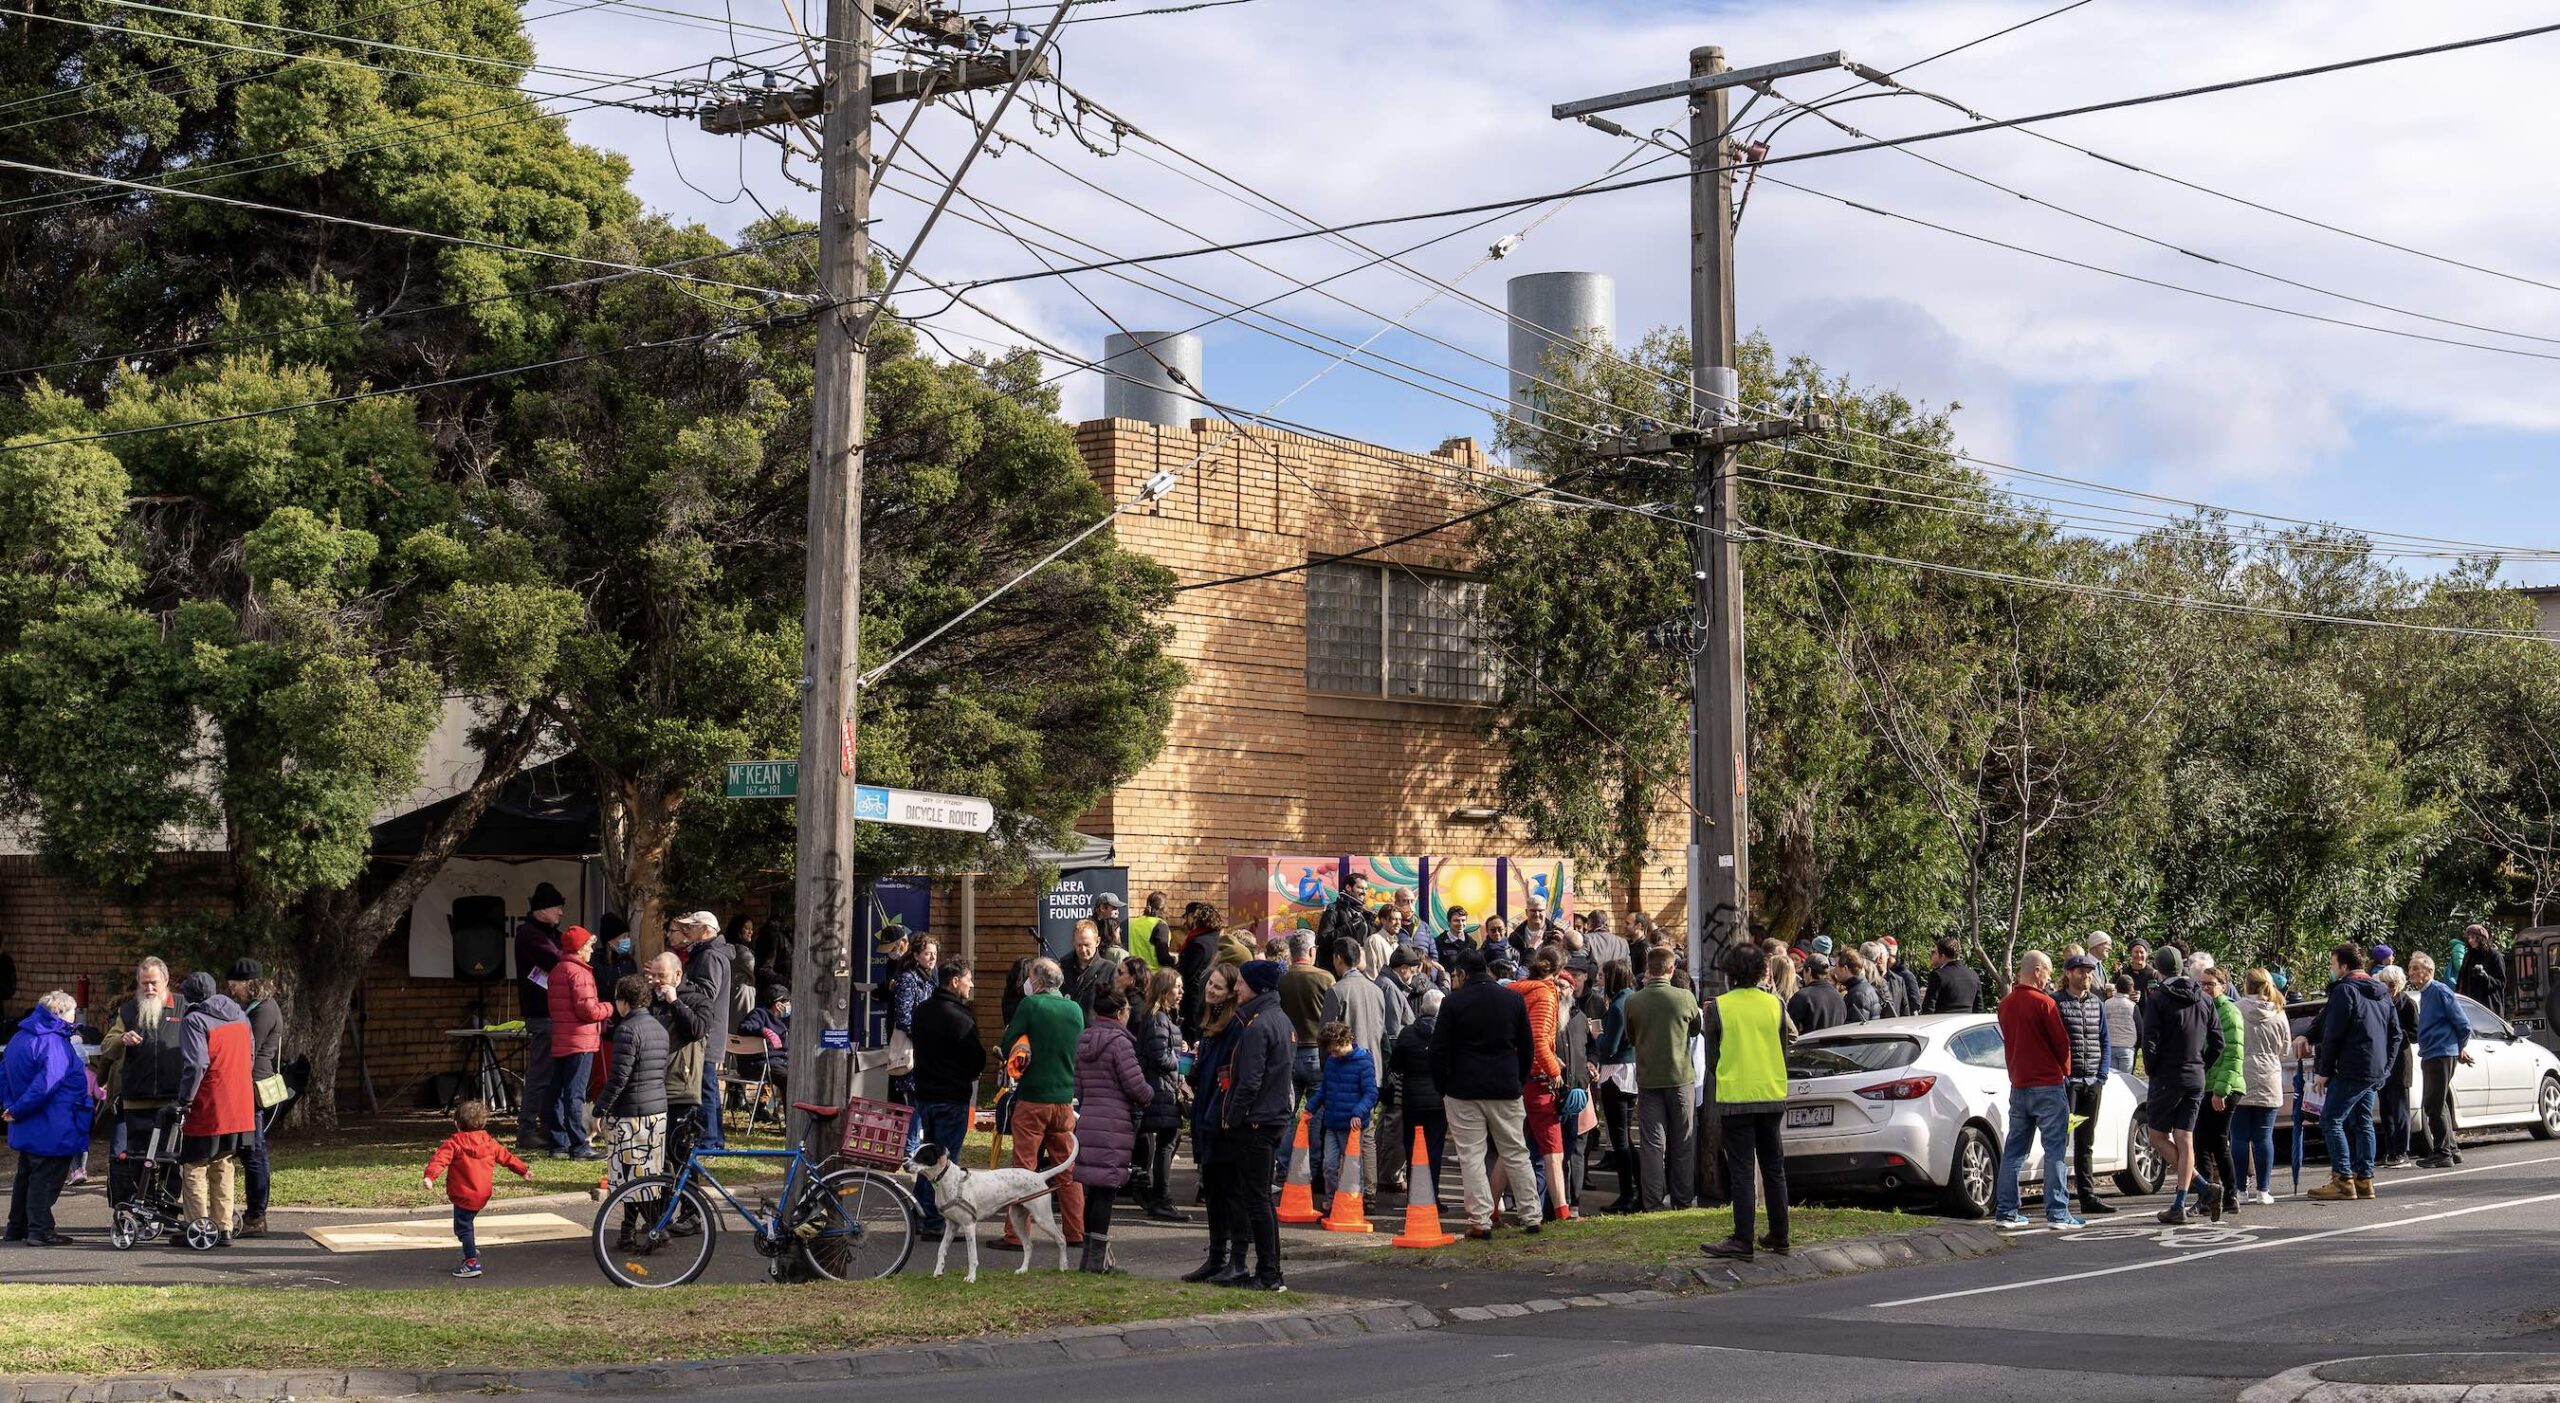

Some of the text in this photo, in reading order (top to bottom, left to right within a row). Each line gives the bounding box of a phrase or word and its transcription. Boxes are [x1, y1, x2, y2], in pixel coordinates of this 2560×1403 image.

[786, 764, 797, 777] ST
[745, 784, 780, 796] 167 191
[906, 804, 979, 827] BICYCLE ROUTE
[1049, 894, 1094, 906] ENERGY
